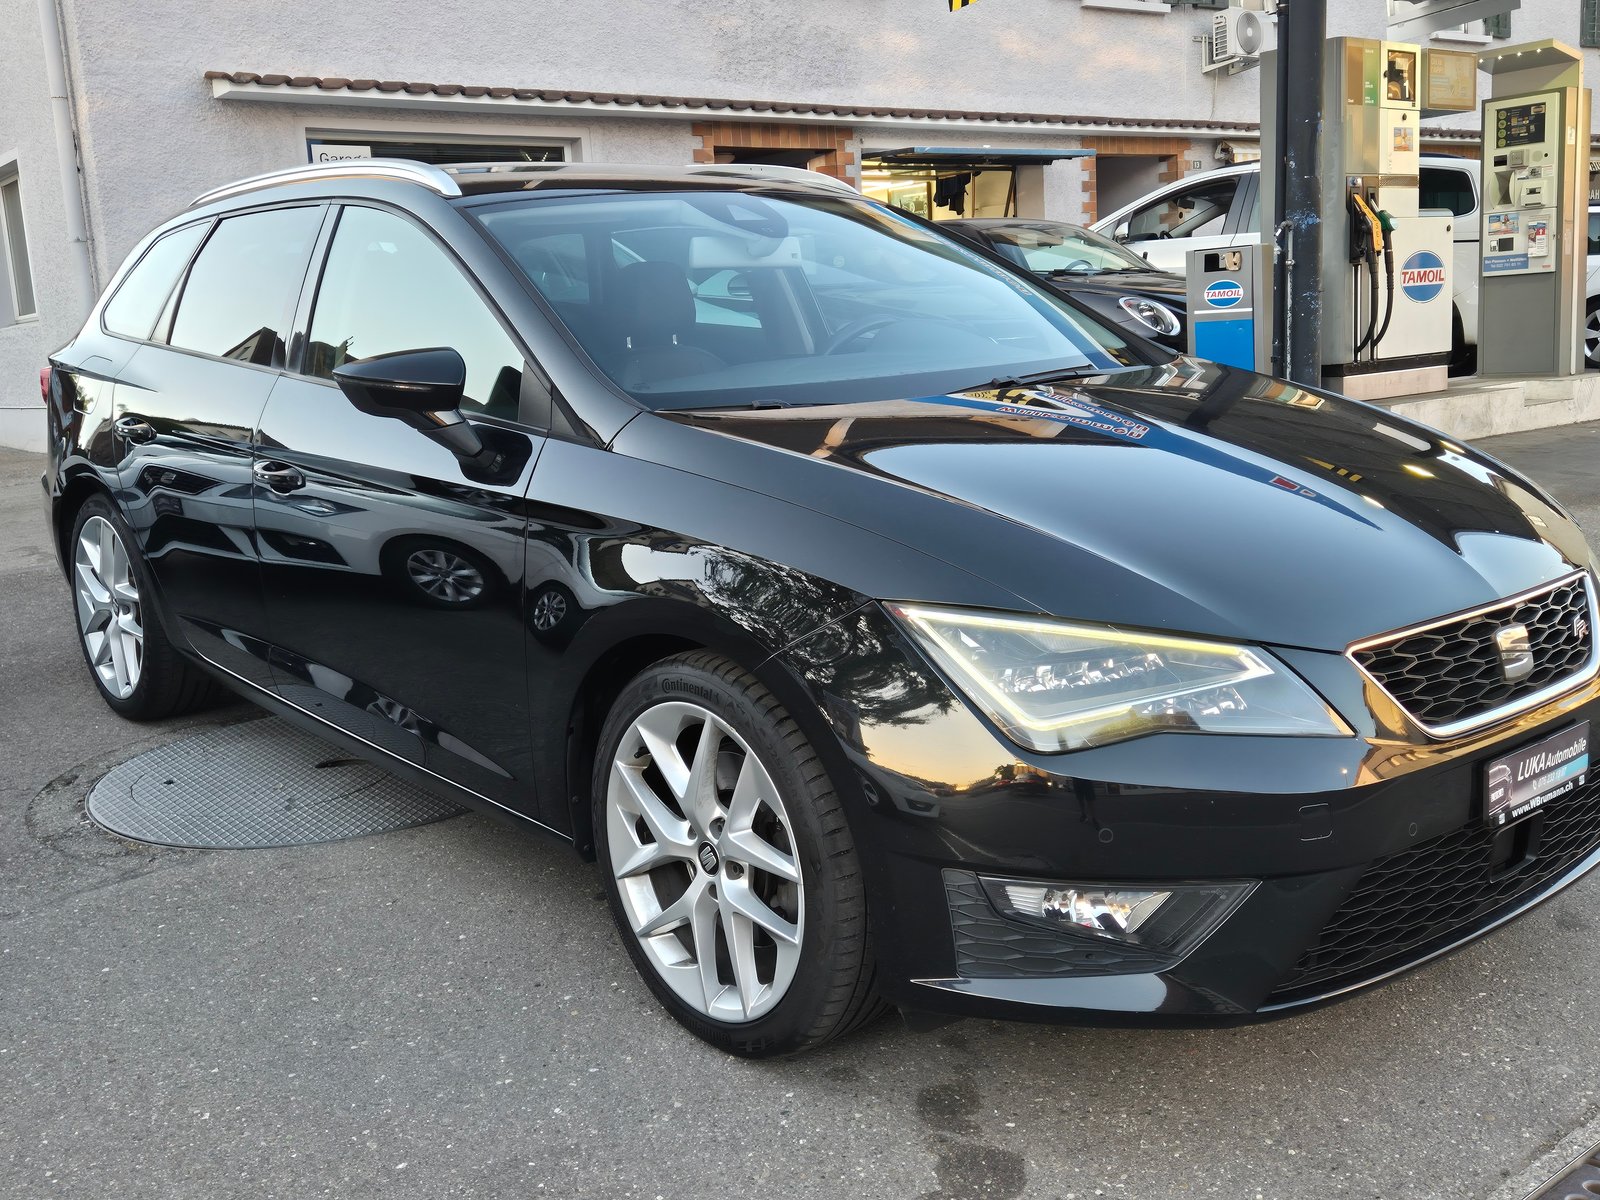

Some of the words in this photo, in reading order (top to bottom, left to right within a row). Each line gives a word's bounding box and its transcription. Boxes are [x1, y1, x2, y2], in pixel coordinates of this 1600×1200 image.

[1401, 268, 1445, 285] TAMOIL
[1204, 288, 1243, 299] TAMOIL
[661, 678, 713, 701] Continental
[1517, 752, 1546, 781] LUKA
[1545, 737, 1587, 770] Automobile
[1511, 781, 1573, 818] www.WBrumann.ch
